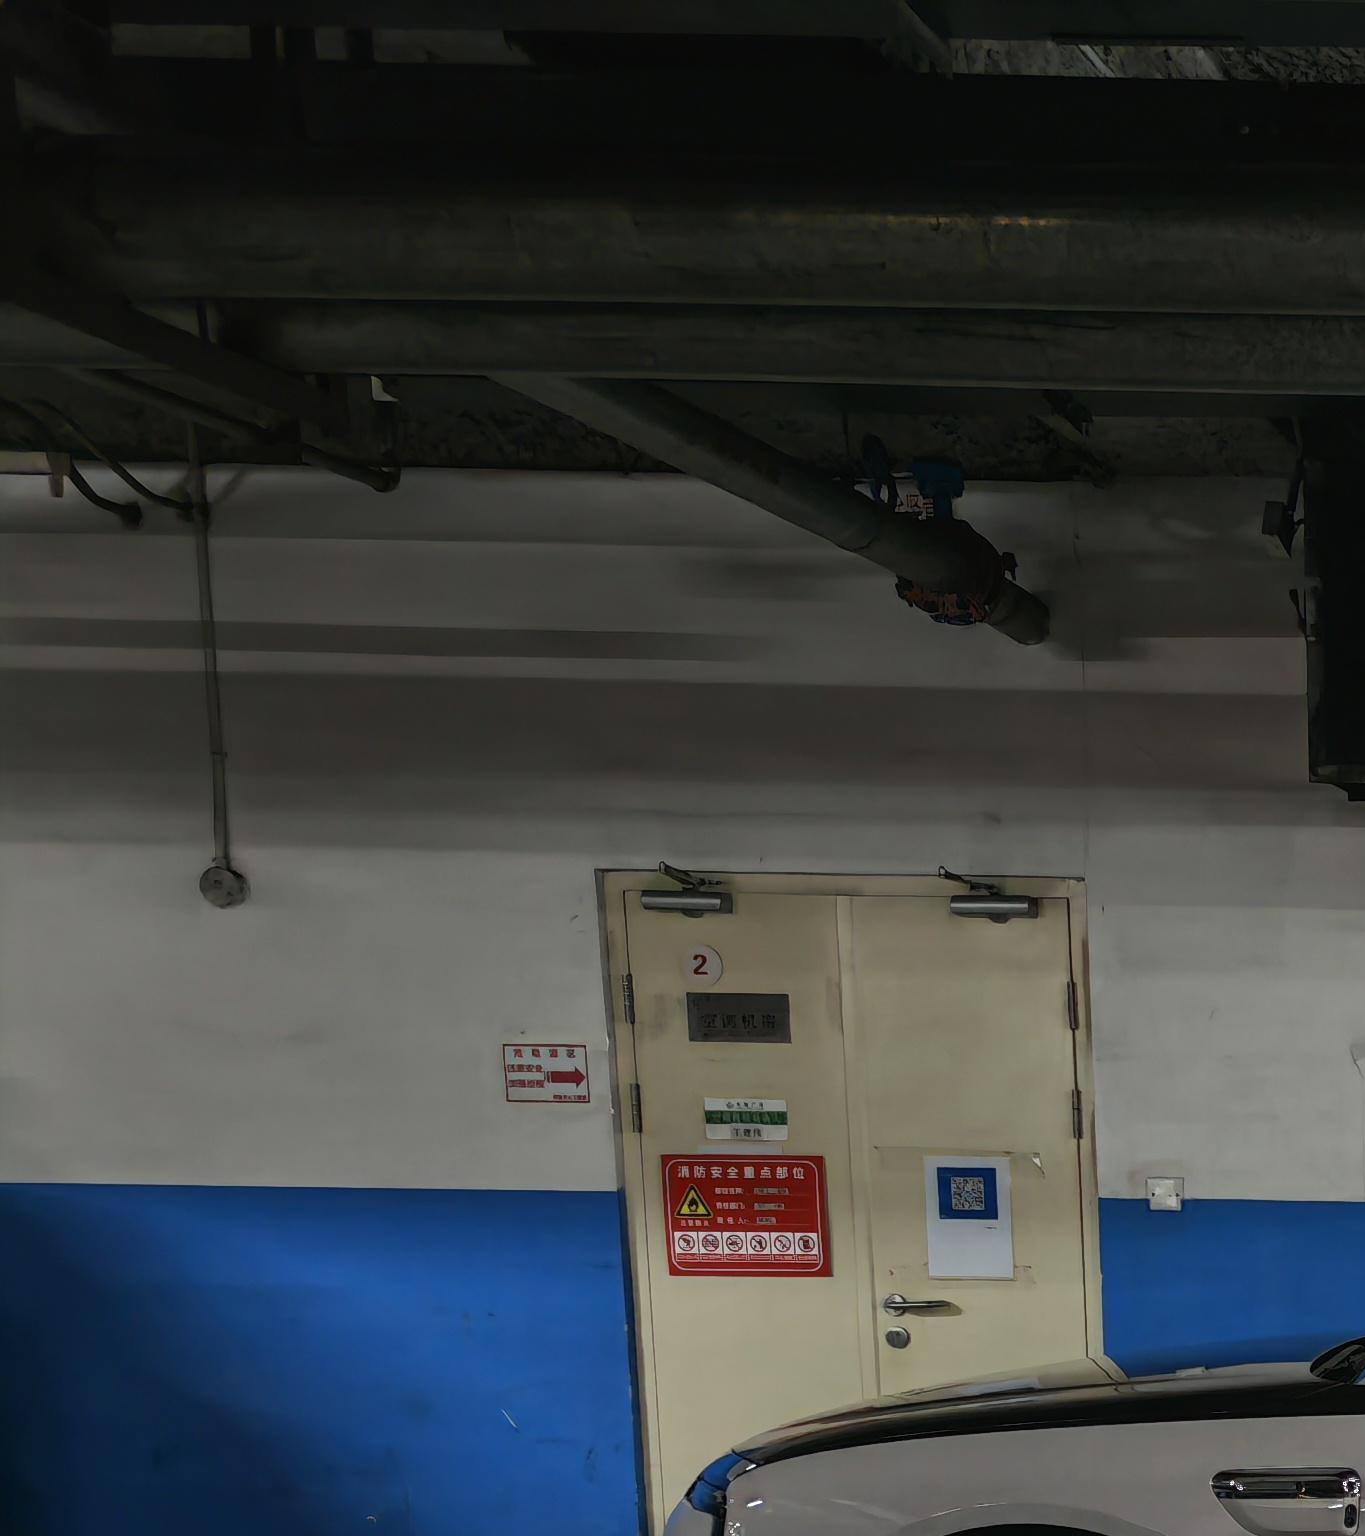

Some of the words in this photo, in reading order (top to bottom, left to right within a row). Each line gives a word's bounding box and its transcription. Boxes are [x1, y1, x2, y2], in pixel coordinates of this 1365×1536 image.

[693, 954, 709, 975] 2
[677, 1166, 805, 1180] 消防安全重点部位
